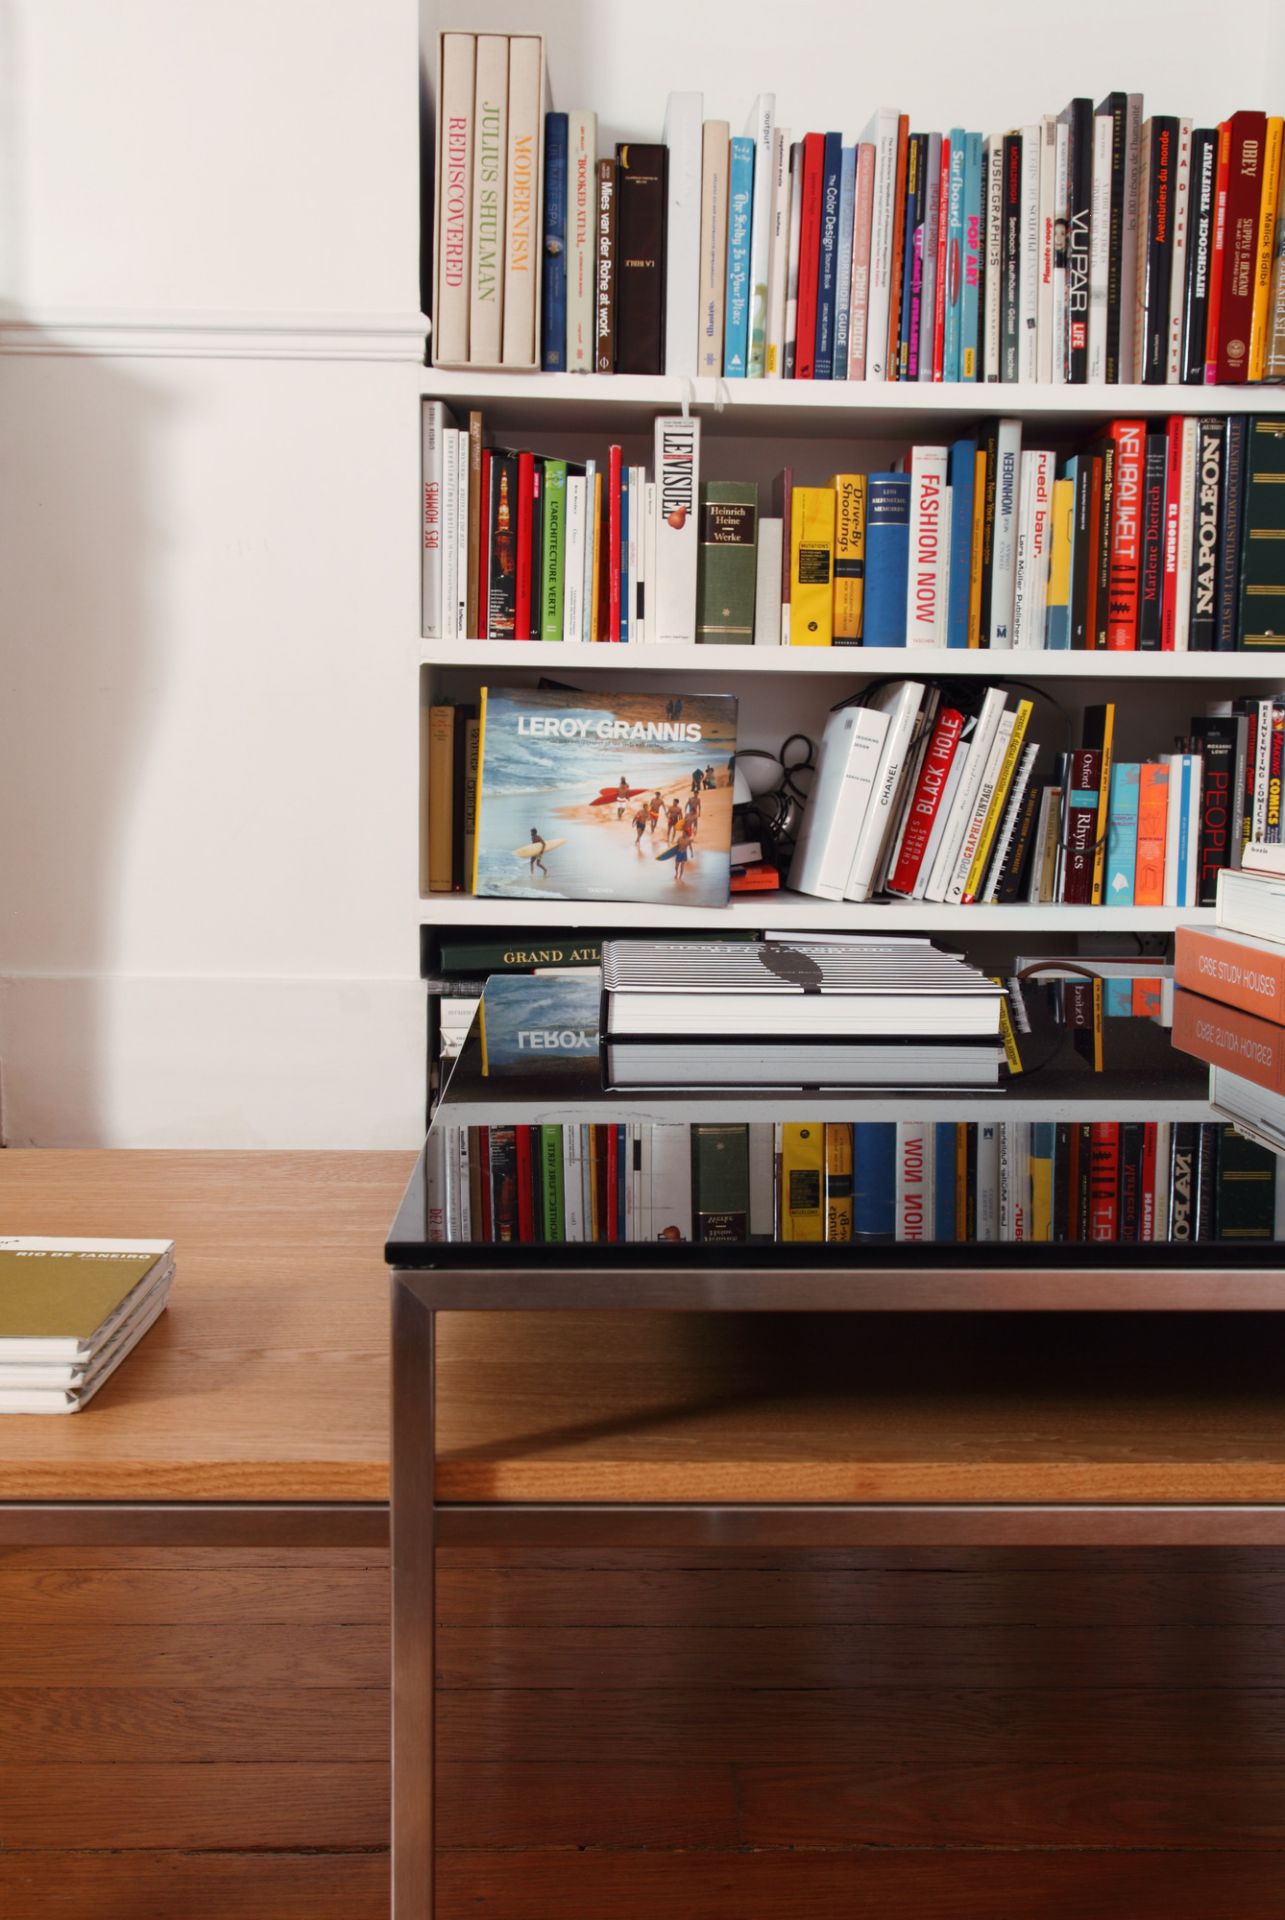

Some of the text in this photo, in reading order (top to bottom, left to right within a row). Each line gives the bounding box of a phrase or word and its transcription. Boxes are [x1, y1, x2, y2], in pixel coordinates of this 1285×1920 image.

[828, 175, 836, 186] The
[1127, 105, 1140, 230] les 100 trésors de l'humanité
[1241, 140, 1258, 177] OBEY
[446, 118, 466, 287] REDISCOVERED
[478, 102, 500, 302] JULIUS SHULMAN
[511, 136, 533, 272] MODERNISM
[826, 188, 838, 214] Color
[950, 150, 963, 228] Surfboard
[1155, 131, 1169, 243] Aventuriers du monde
[548, 203, 558, 226] SPA
[823, 216, 837, 251] Design
[1008, 217, 1017, 255] Sembach
[1027, 205, 1037, 252] PHOTOS
[1241, 218, 1253, 250] SUPPLY
[599, 182, 612, 337] Mies van der Rohe at work
[966, 216, 978, 288] POP ART
[1043, 217, 1052, 283] Planète rouge
[1071, 210, 1089, 311] VU PAR
[1259, 212, 1273, 286] Malick Sidibé
[824, 274, 832, 289] Book
[838, 243, 851, 310] STORMRIDER
[856, 265, 866, 305] TRACK
[1238, 261, 1250, 296] DEMAND
[838, 314, 848, 346] GUIDE
[855, 309, 865, 359] HIDDEN
[1073, 323, 1084, 348] LIFE
[1006, 347, 1014, 379] Taschen
[472, 421, 481, 440] Andy
[663, 432, 694, 454] LE
[986, 482, 995, 500] New
[1001, 452, 1015, 516] WOHNIDEEN
[1103, 449, 1113, 501] Fantastic Tales
[1115, 427, 1140, 560] NEUBAUWELT
[425, 482, 438, 548] DES HOMMES
[711, 507, 746, 516] Heinrich
[716, 517, 740, 525] Heine
[840, 483, 852, 552] Shootings
[851, 488, 862, 547] Drive-By
[918, 474, 940, 564] FASHION
[985, 502, 994, 523] York
[1033, 454, 1048, 559] ruedi baur.
[1145, 485, 1160, 540] Dietrich
[1196, 435, 1221, 614] NAPOLÉON
[1221, 422, 1241, 641] ATLAS DE LA CIVILISATION OCCIDENTALE
[548, 501, 558, 617] L'ARCHITECTURE VERTE
[714, 533, 742, 542] Werke
[1166, 504, 1177, 573] EL BORBAH
[1017, 560, 1025, 590] Müller
[1144, 545, 1158, 600] Marlene
[916, 573, 937, 624] NOW
[1014, 594, 1023, 645] Publishers
[518, 716, 702, 742] LEROY GRANNIS
[1016, 708, 1029, 732] secrets
[1259, 705, 1267, 779] REINVENTING
[917, 716, 959, 815] BLACK HOLE
[1006, 738, 1021, 759] digital
[1082, 754, 1093, 789] Oxford
[881, 764, 898, 806] CHANEL
[996, 759, 1014, 794] illustration
[1268, 733, 1283, 824] MAKING COMICS
[901, 819, 921, 864] CHARLES
[912, 828, 927, 861] BURNS
[1203, 772, 1229, 881] PEOPLE
[503, 950, 563, 964] GRAND
[1200, 956, 1276, 997] CASE STUDY HOUSES
